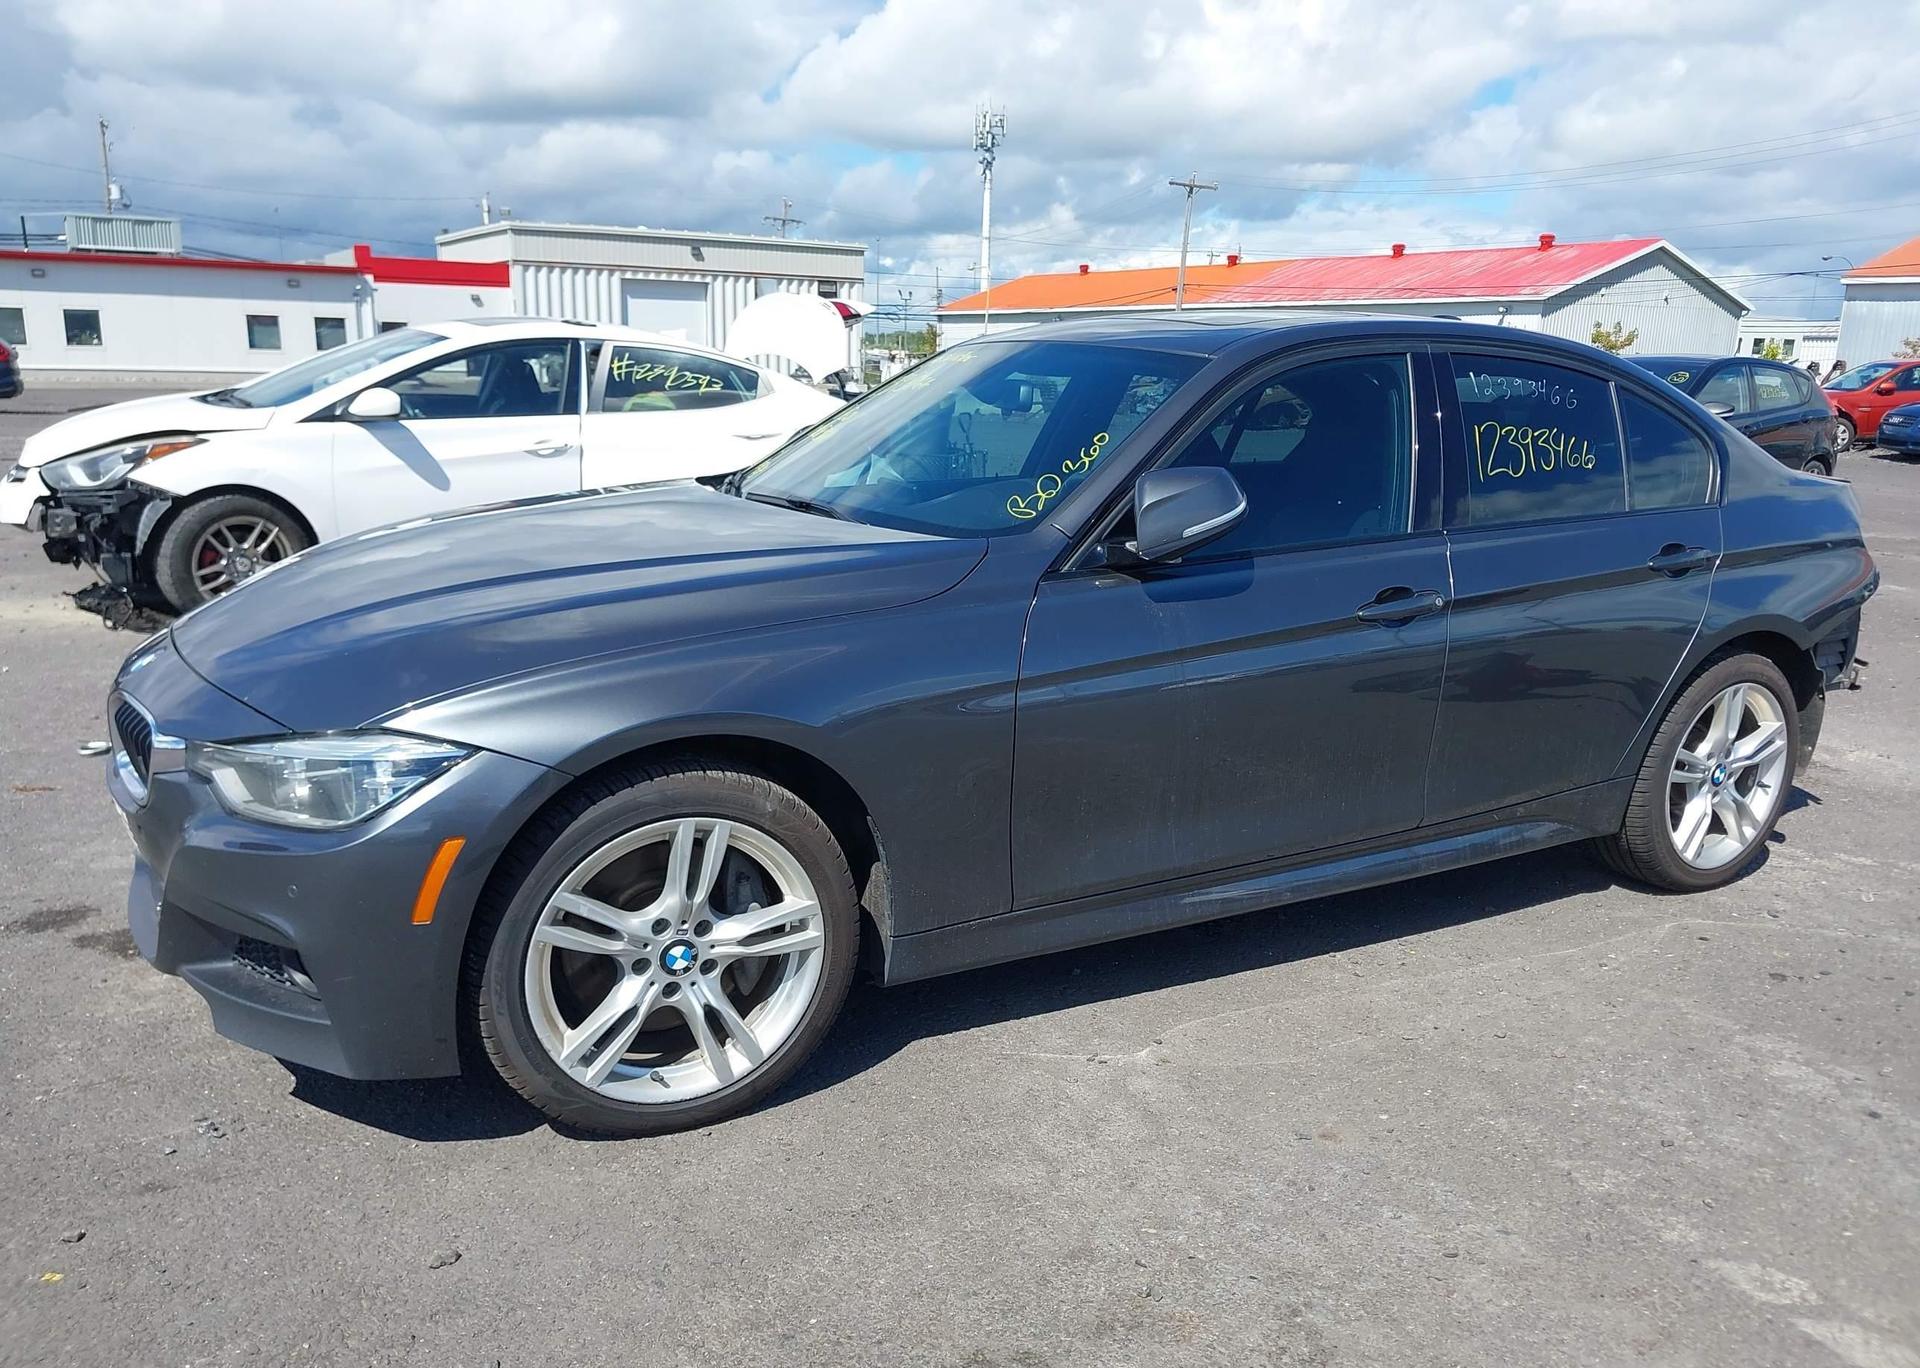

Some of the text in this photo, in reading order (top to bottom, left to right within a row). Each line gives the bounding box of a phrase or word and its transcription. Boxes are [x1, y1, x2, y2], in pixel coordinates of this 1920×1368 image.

[1469, 371, 1577, 409] 12393466
[1062, 432, 1109, 473] 360
[1474, 421, 1596, 483] 12393466
